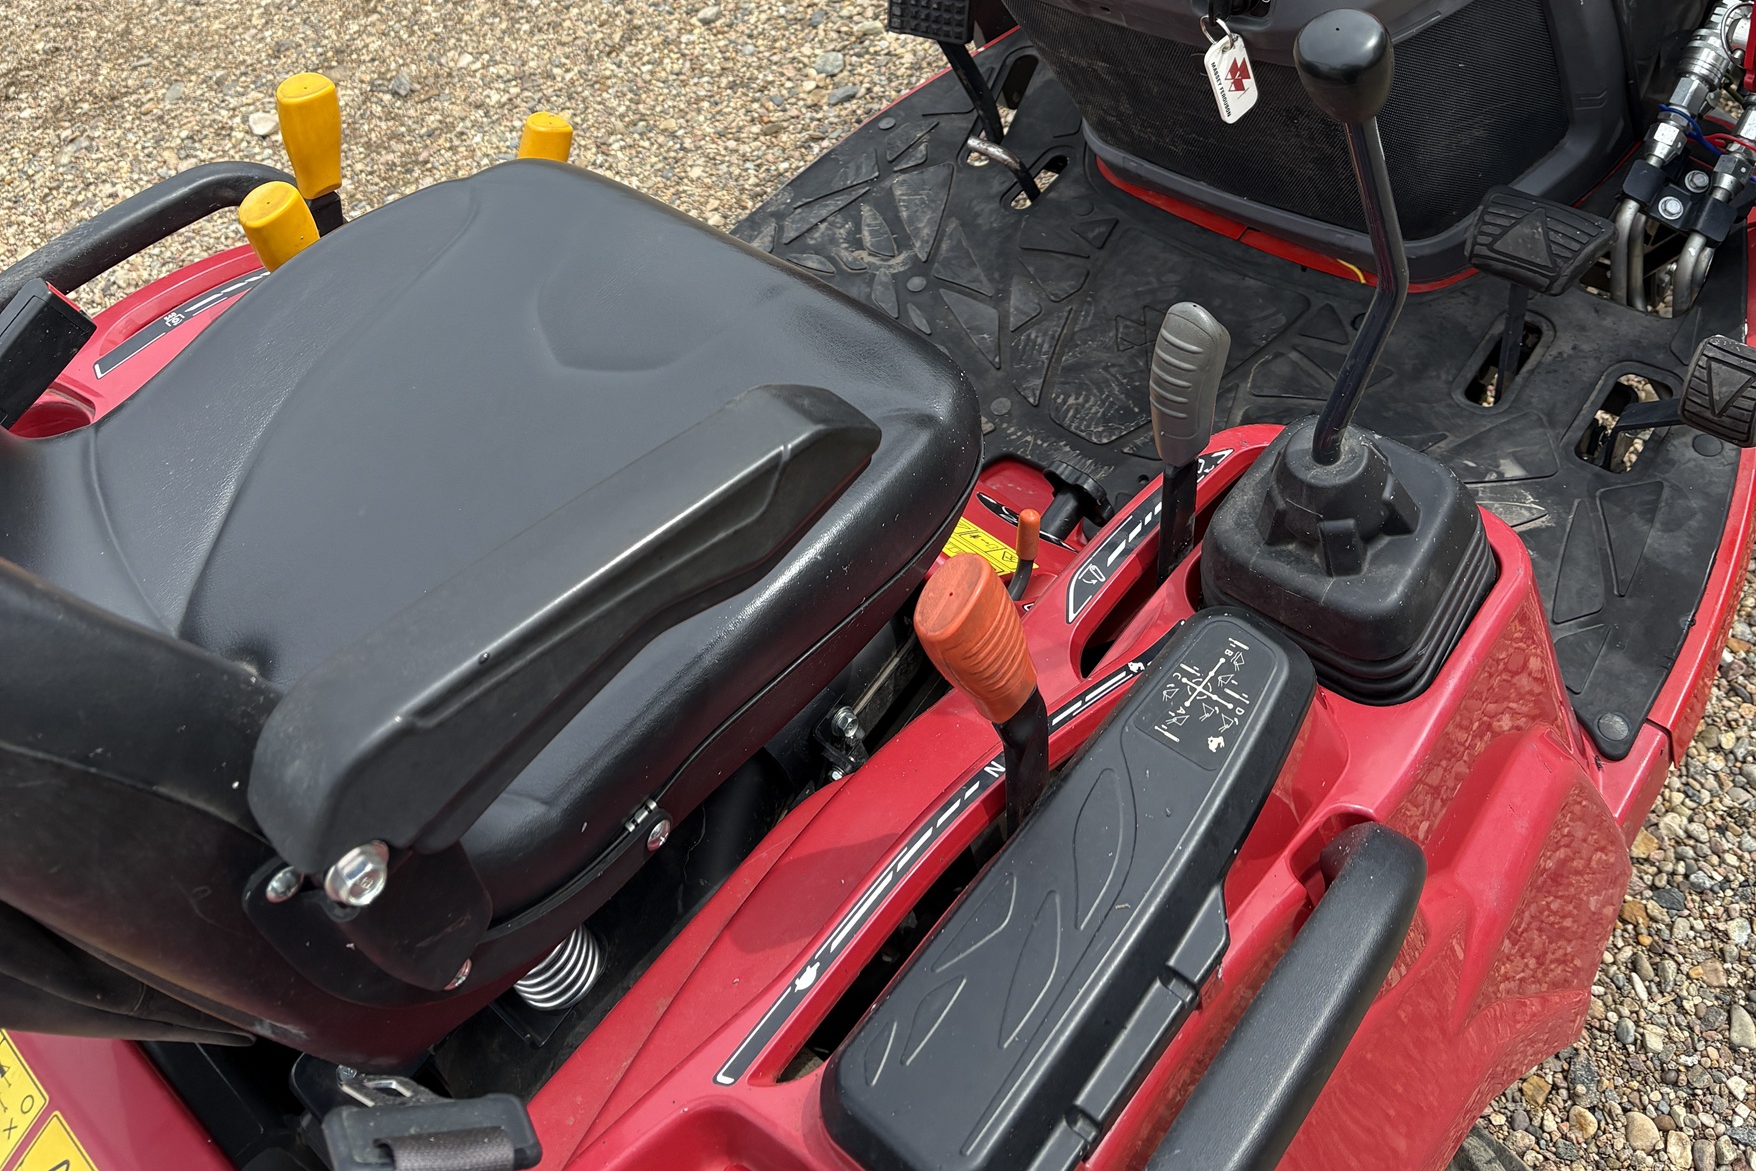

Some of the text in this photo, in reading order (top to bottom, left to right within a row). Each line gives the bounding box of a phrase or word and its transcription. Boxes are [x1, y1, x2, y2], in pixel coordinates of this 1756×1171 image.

[1210, 61, 1232, 118] MASSEY FERGUSON
[1236, 707, 1244, 715] D
[983, 760, 1006, 778] N
